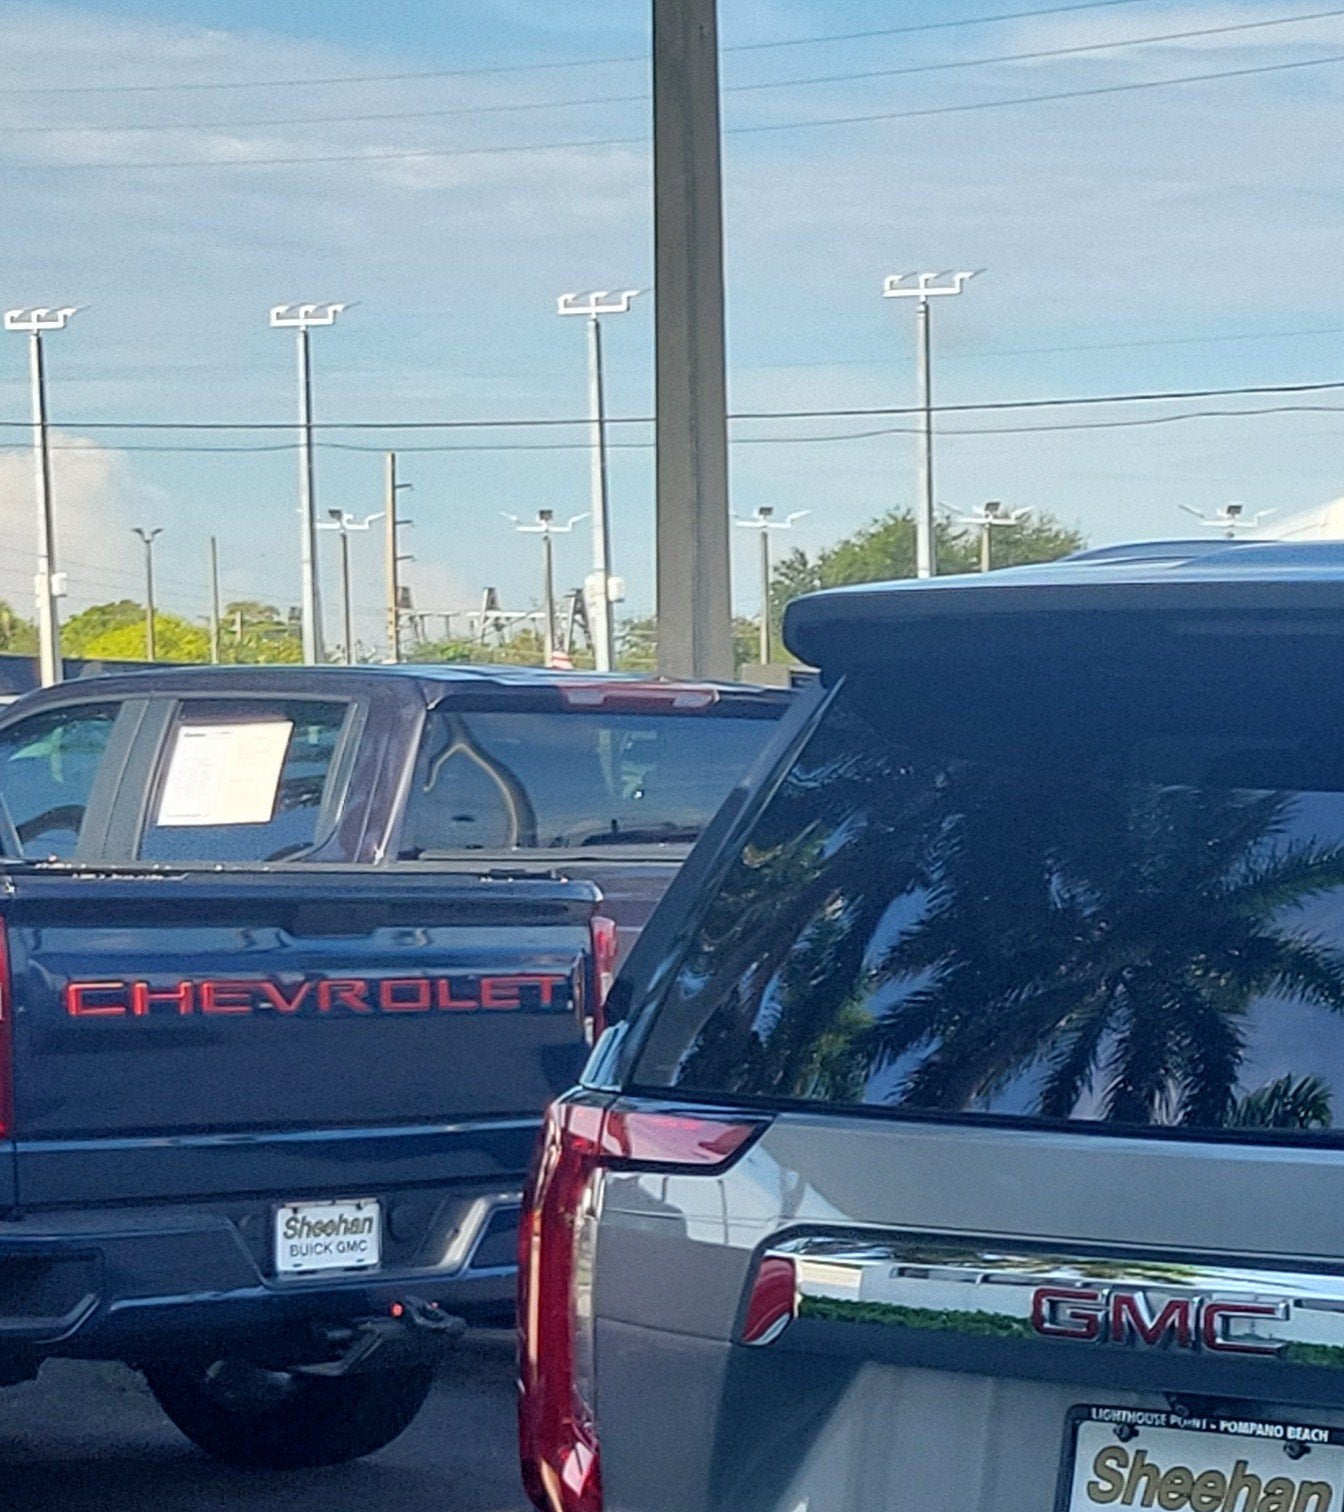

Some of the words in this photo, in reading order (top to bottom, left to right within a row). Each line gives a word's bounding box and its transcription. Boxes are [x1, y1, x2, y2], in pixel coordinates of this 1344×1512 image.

[65, 975, 568, 1018] CHEVROLET
[282, 1213, 374, 1240] Sheehan
[289, 1243, 334, 1257] BUICK
[336, 1240, 368, 1254] GMC
[1029, 1286, 1292, 1358] GMC
[1091, 1406, 1167, 1427] LIGHTHOUSE
[1219, 1418, 1285, 1440] POMPANO
[1286, 1427, 1330, 1443] BEACH
